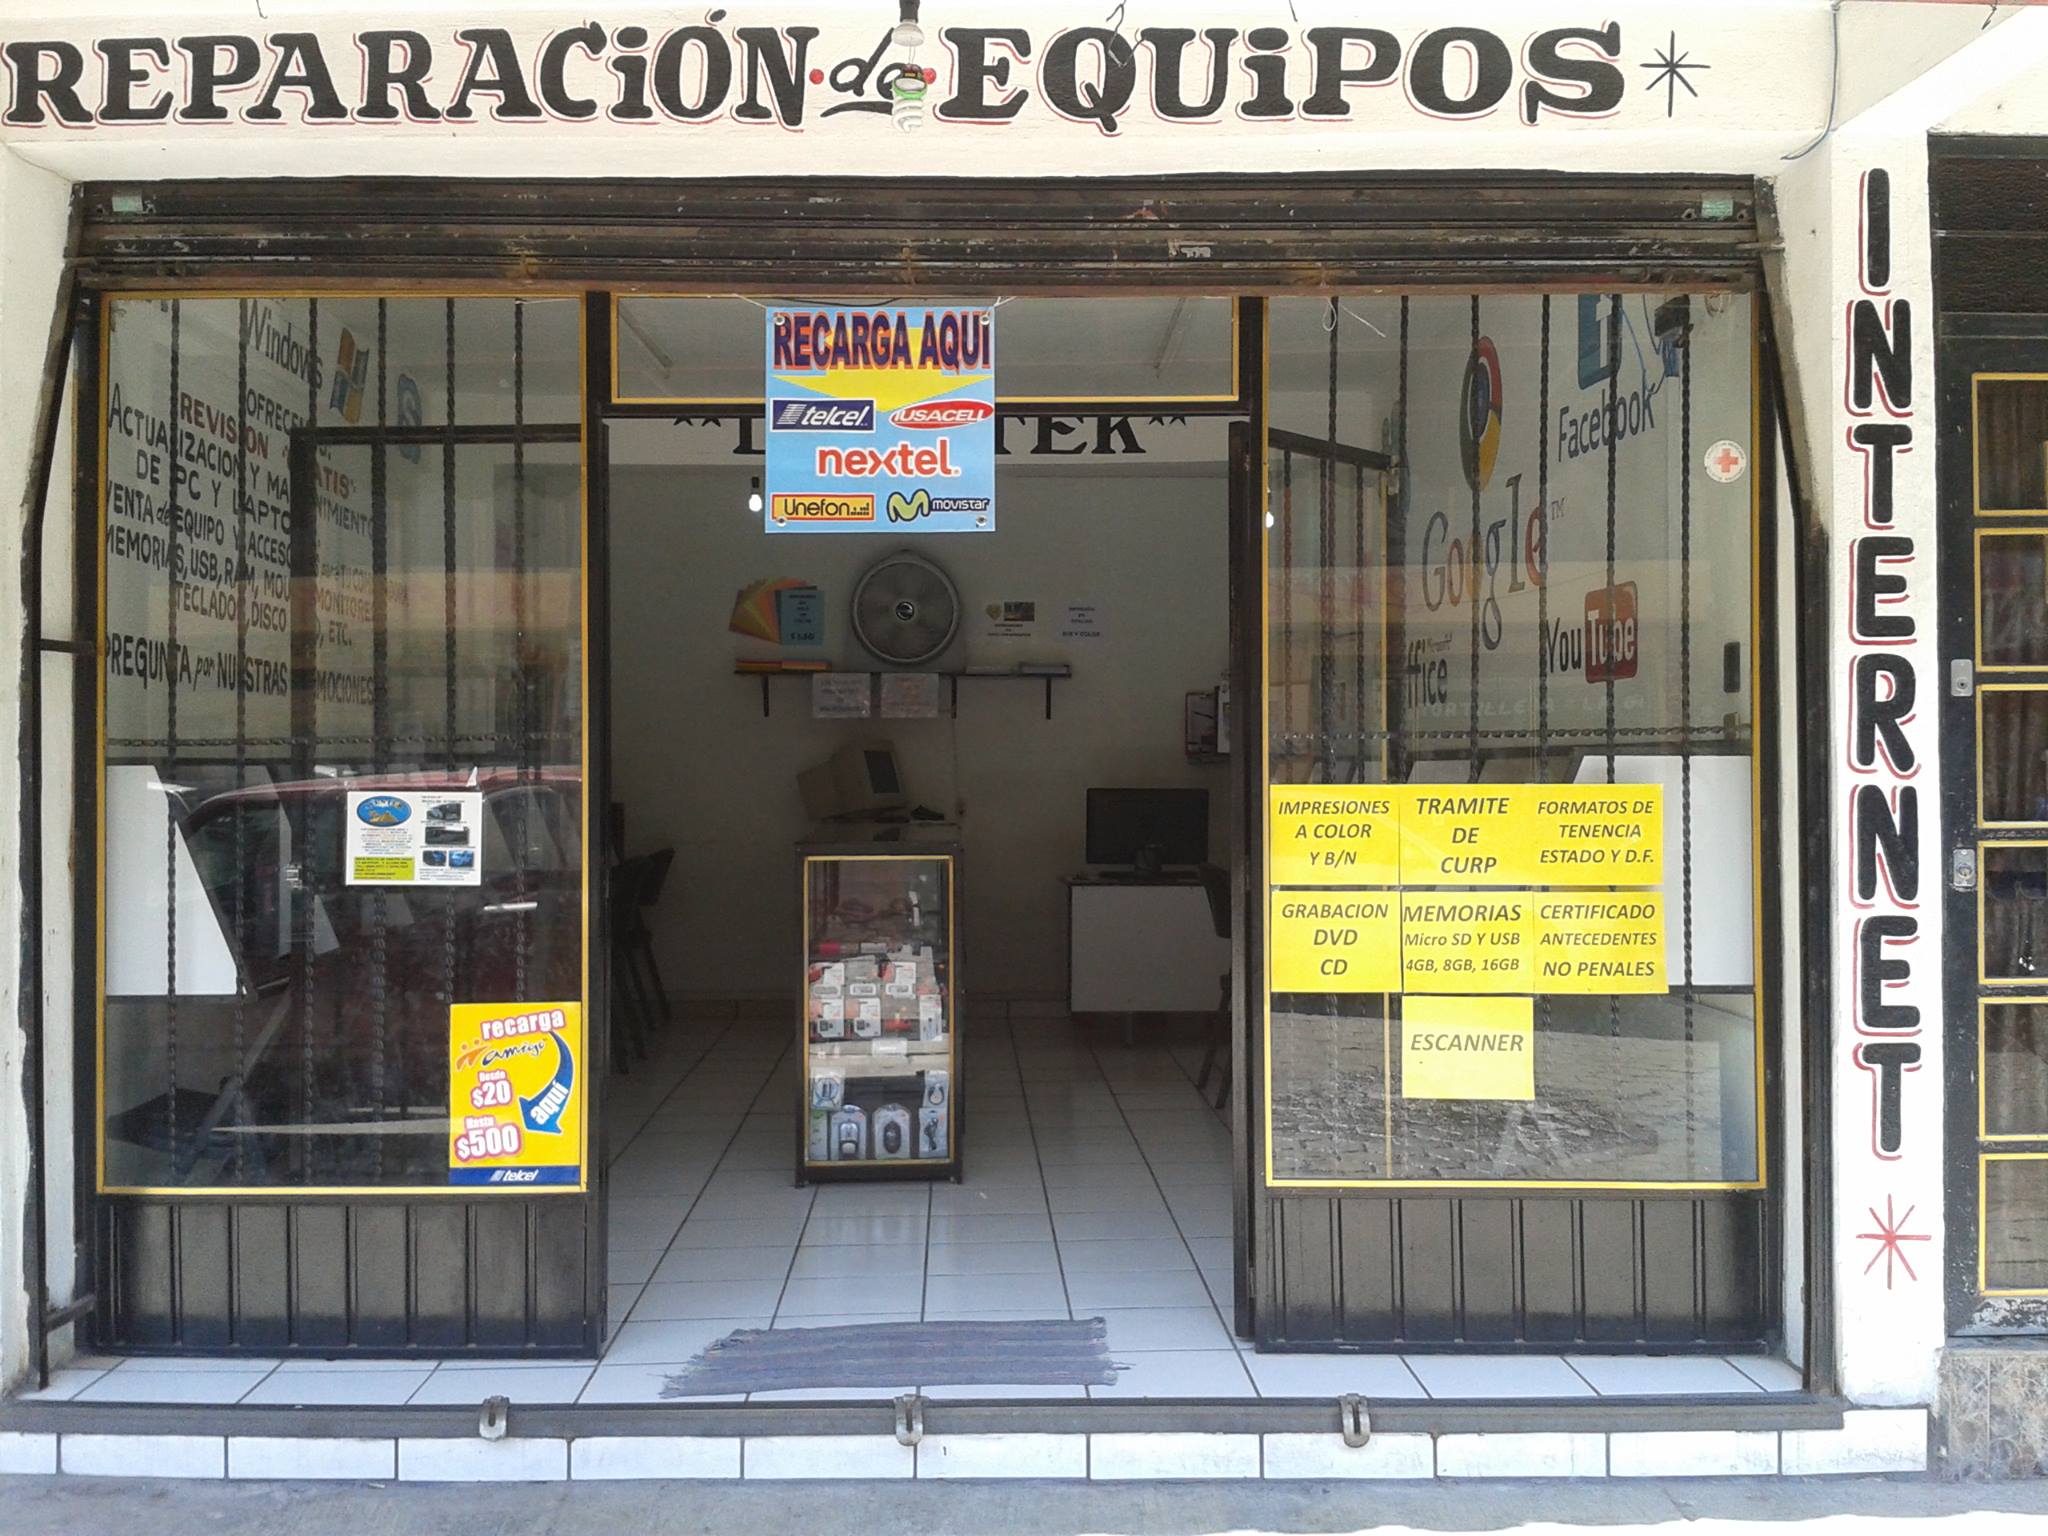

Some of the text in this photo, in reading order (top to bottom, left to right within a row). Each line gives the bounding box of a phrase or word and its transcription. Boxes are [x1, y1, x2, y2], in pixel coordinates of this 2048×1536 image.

[773, 311, 913, 370] RECARGA
[799, 404, 987, 427] telcel IUSACELL
[1558, 383, 1655, 462] Facebook
[180, 391, 269, 459] REVISON
[107, 382, 241, 480] ACTUAIZACION
[250, 461, 261, 490] Y
[819, 439, 952, 475] nextel
[137, 449, 161, 485] DE
[174, 463, 201, 500] PC
[211, 478, 222, 508] Y
[784, 498, 988, 517] Unefon movistar
[173, 504, 225, 547] EQUIPO
[1421, 473, 1548, 651] Google
[251, 600, 287, 633] DISCO
[1848, 168, 1922, 1156] INTERNET
[217, 652, 288, 696] NUSTRAS
[1406, 640, 1448, 709] ffice
[1278, 801, 1390, 815] IMPRESIONES
[1416, 798, 1510, 815] TRAMITE
[1537, 801, 1654, 815] FORMATOS DE
[1295, 823, 1372, 839] A COLOR
[1451, 828, 1479, 844] DE
[1559, 824, 1641, 839] TENENCIA
[1310, 850, 1357, 867] Y B/N
[1440, 857, 1497, 874] CURP
[1539, 849, 1655, 864] ESTADO Y D.F.
[1281, 903, 1389, 920] GRABACION
[1402, 904, 1522, 922] MEMORIAS
[1540, 903, 1656, 920] CERTIFICADO
[1312, 928, 1358, 946] DVD
[1404, 932, 1521, 947] Micro SD Y USB
[1540, 932, 1658, 946] ANTECEDENTES
[1320, 959, 1348, 976] CD
[1405, 958, 1520, 974] 4GB, 8GB, 16GB
[1543, 961, 1655, 977] NO PENALES
[481, 1009, 566, 1040] recarga
[1410, 1034, 1524, 1051] ESCANNER
[482, 1041, 545, 1066] amigo
[479, 1070, 506, 1083] Desde
[472, 1080, 512, 1108] $20
[530, 1080, 569, 1125] aquí
[455, 1124, 521, 1161] $500
[503, 1169, 539, 1182] telcel
